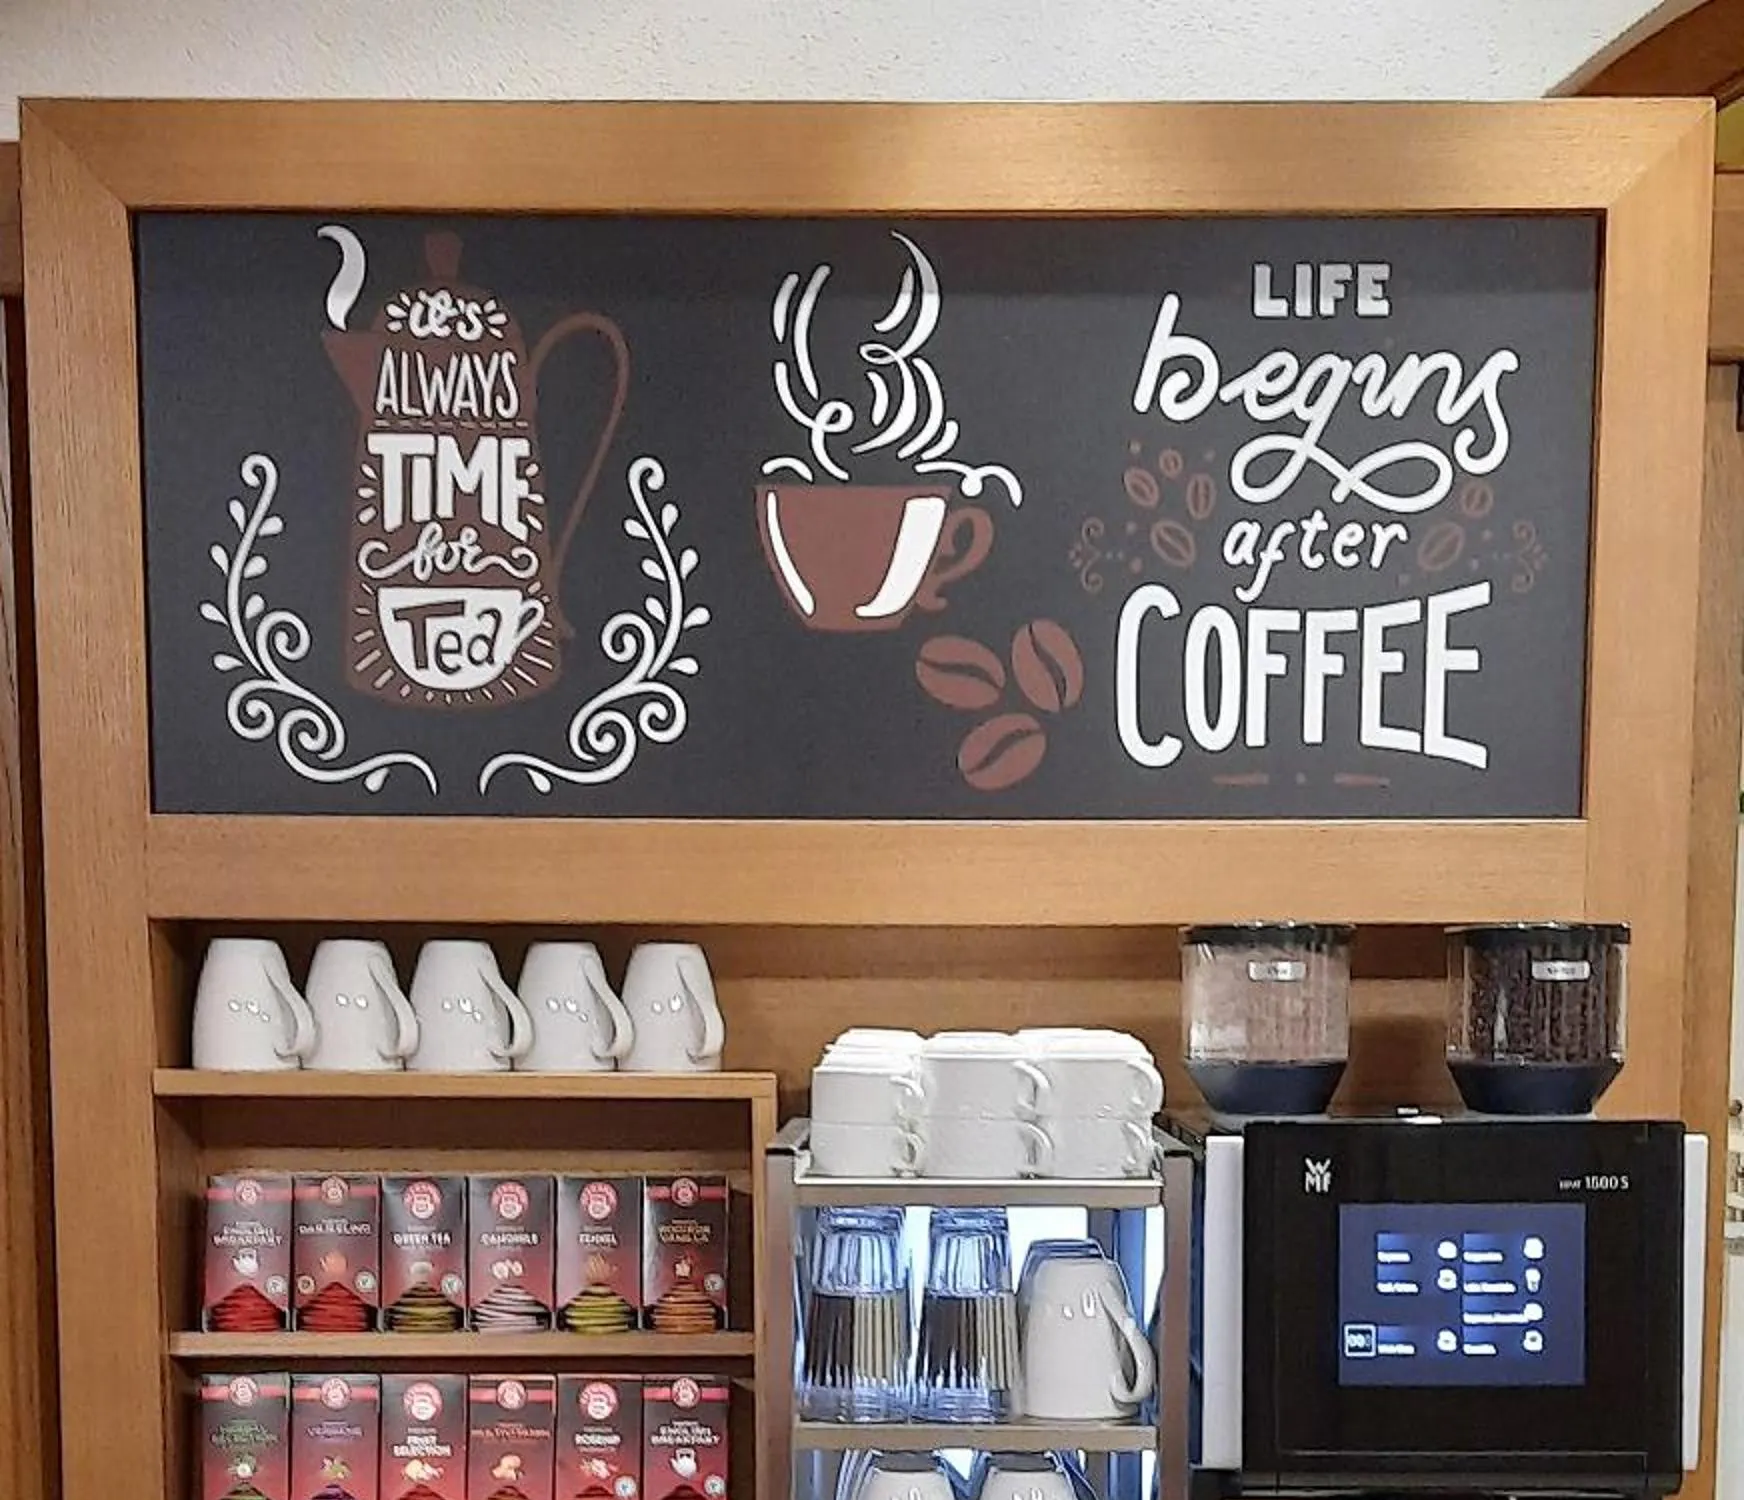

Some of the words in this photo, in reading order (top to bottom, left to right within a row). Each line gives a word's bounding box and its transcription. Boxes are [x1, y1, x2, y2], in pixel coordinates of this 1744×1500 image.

[1252, 263, 1391, 318] LIFE
[374, 347, 519, 419] ALWAYS
[1132, 292, 1520, 513] begins
[366, 432, 532, 542] TIME
[1221, 509, 1409, 602] after
[392, 599, 504, 676] Tea
[1114, 580, 1492, 769] COFFEE
[1620, 1175, 1629, 1190] S
